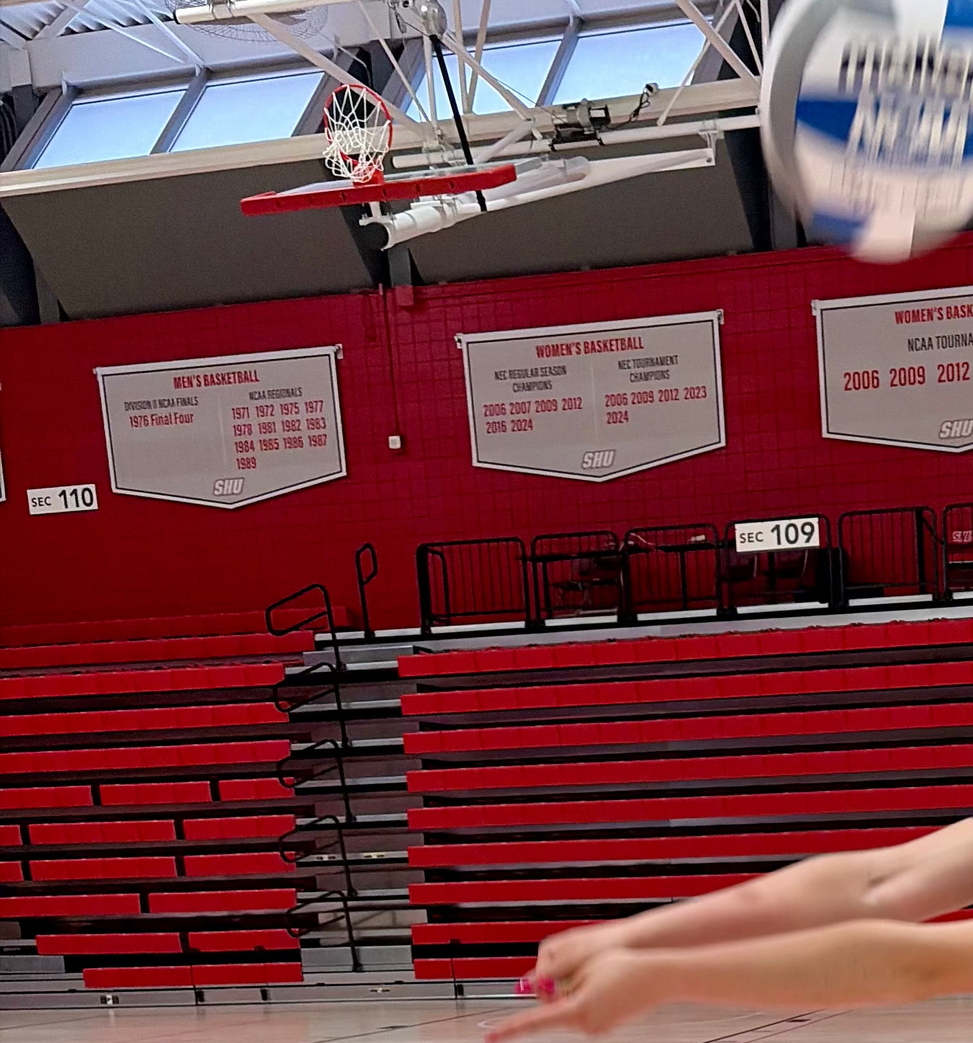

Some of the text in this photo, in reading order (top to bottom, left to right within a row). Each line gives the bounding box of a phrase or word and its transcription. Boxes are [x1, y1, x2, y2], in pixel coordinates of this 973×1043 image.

[894, 307, 944, 325] WOMEN'S
[536, 336, 644, 359] WOMEN'S BASKETBALL
[907, 336, 933, 352] NCAA
[618, 355, 679, 370] NEC TOURNAMENT
[173, 370, 260, 389] MEN'S BASKETBALL
[494, 365, 567, 381] NEC REGULAR SEASON
[629, 369, 670, 383] CHAMPIONS
[843, 370, 880, 391] 2006
[889, 366, 926, 387] 2009
[937, 361, 971, 383] 2012
[267, 387, 302, 399] REGIONALS
[512, 380, 552, 393] CHAMPIONS
[176, 396, 198, 407] FINALS
[605, 386, 707, 407] 2006 2009 2012 2023
[232, 400, 324, 420] 1971 1972 1975 1977
[483, 397, 583, 417] 2006 2007 2009 2012
[129, 412, 194, 428] 1976 Final Four
[511, 419, 534, 432] 2024
[606, 410, 629, 425] 2024
[233, 417, 326, 437] 1978 1981 1982 1983
[235, 441, 255, 453] 1984
[308, 434, 327, 447] 1987
[236, 457, 257, 470] 1989
[581, 449, 616, 470] SHU
[213, 477, 245, 496] SHU
[31, 487, 94, 509] SEC 110
[739, 521, 815, 545] SEC 109
